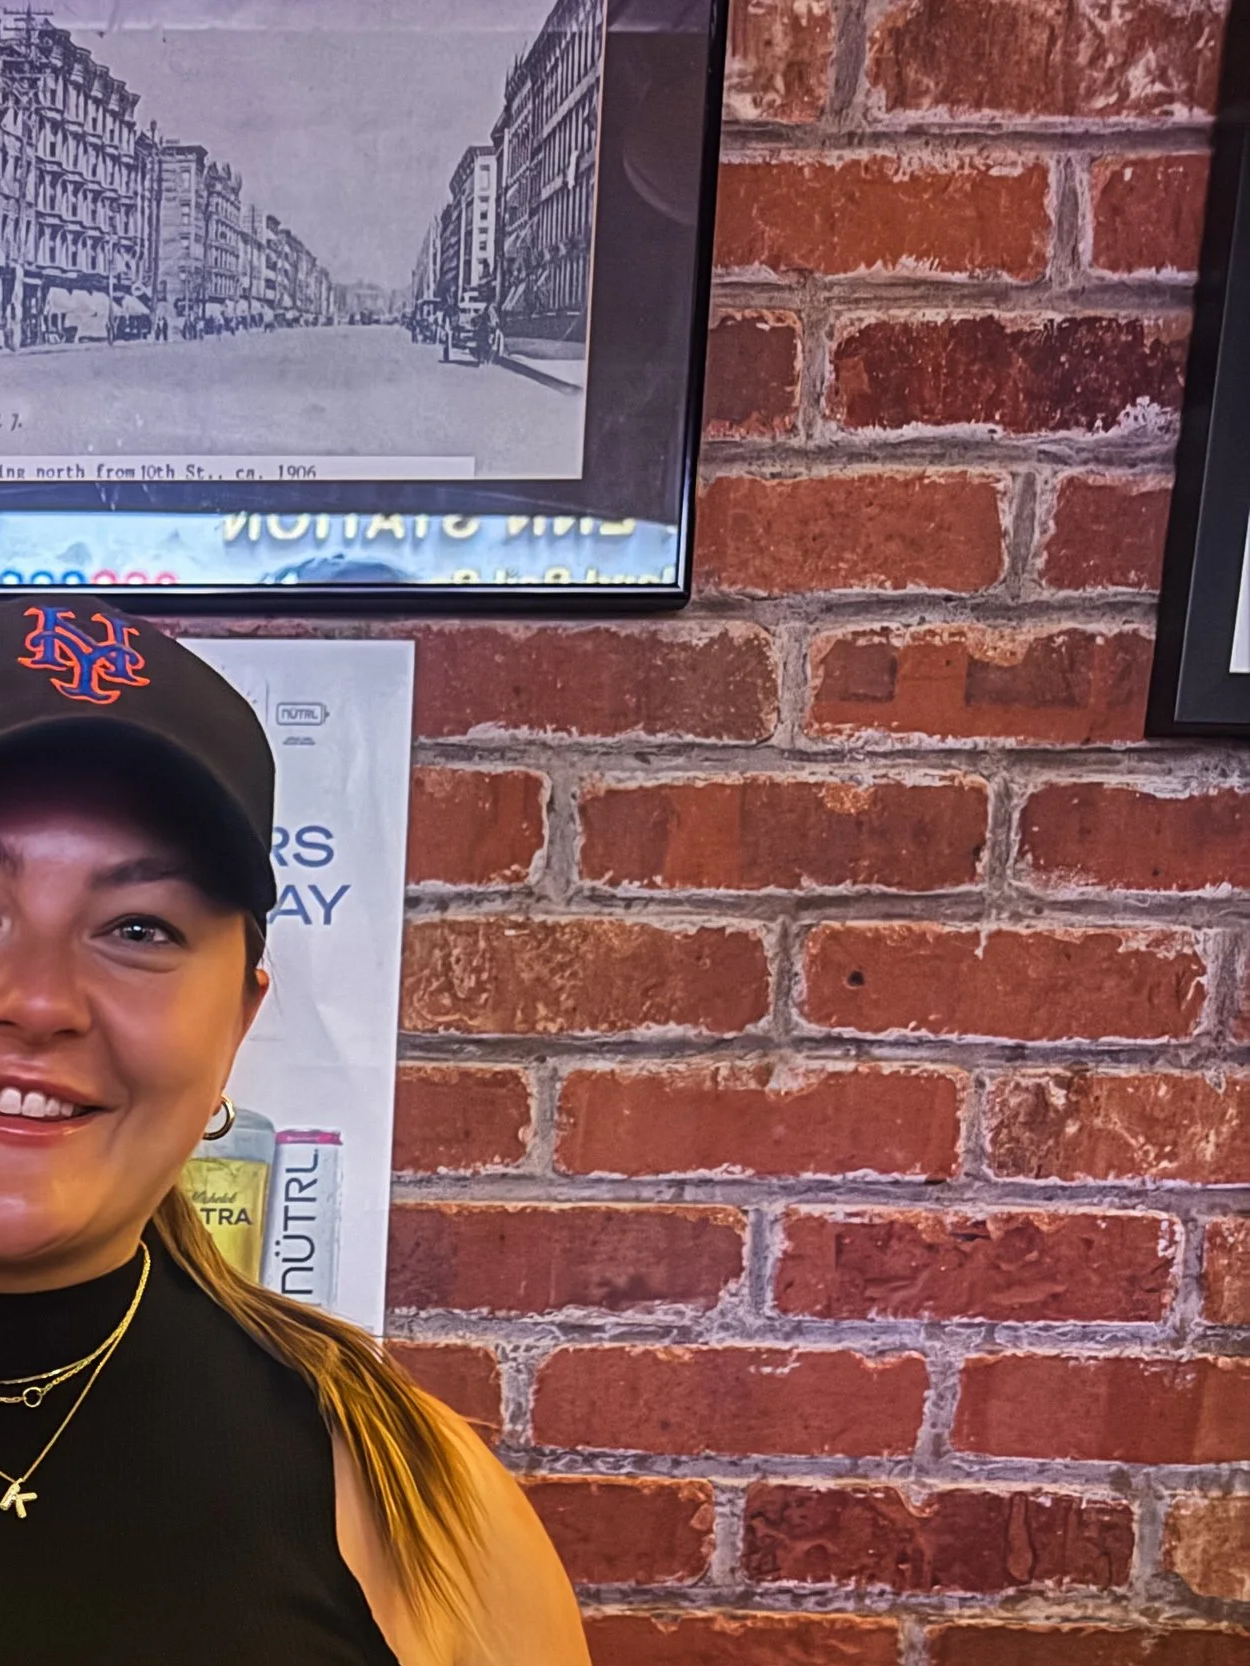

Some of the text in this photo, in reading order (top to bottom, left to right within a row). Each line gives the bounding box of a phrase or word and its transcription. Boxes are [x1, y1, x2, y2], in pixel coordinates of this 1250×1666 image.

[36, 464, 85, 479] north
[96, 463, 136, 479] from
[140, 463, 175, 479] 10th
[278, 464, 317, 479] 1906
[16, 605, 151, 705] NY
[272, 825, 335, 868] RS
[266, 884, 352, 926] AY
[200, 1207, 254, 1226] TRA
